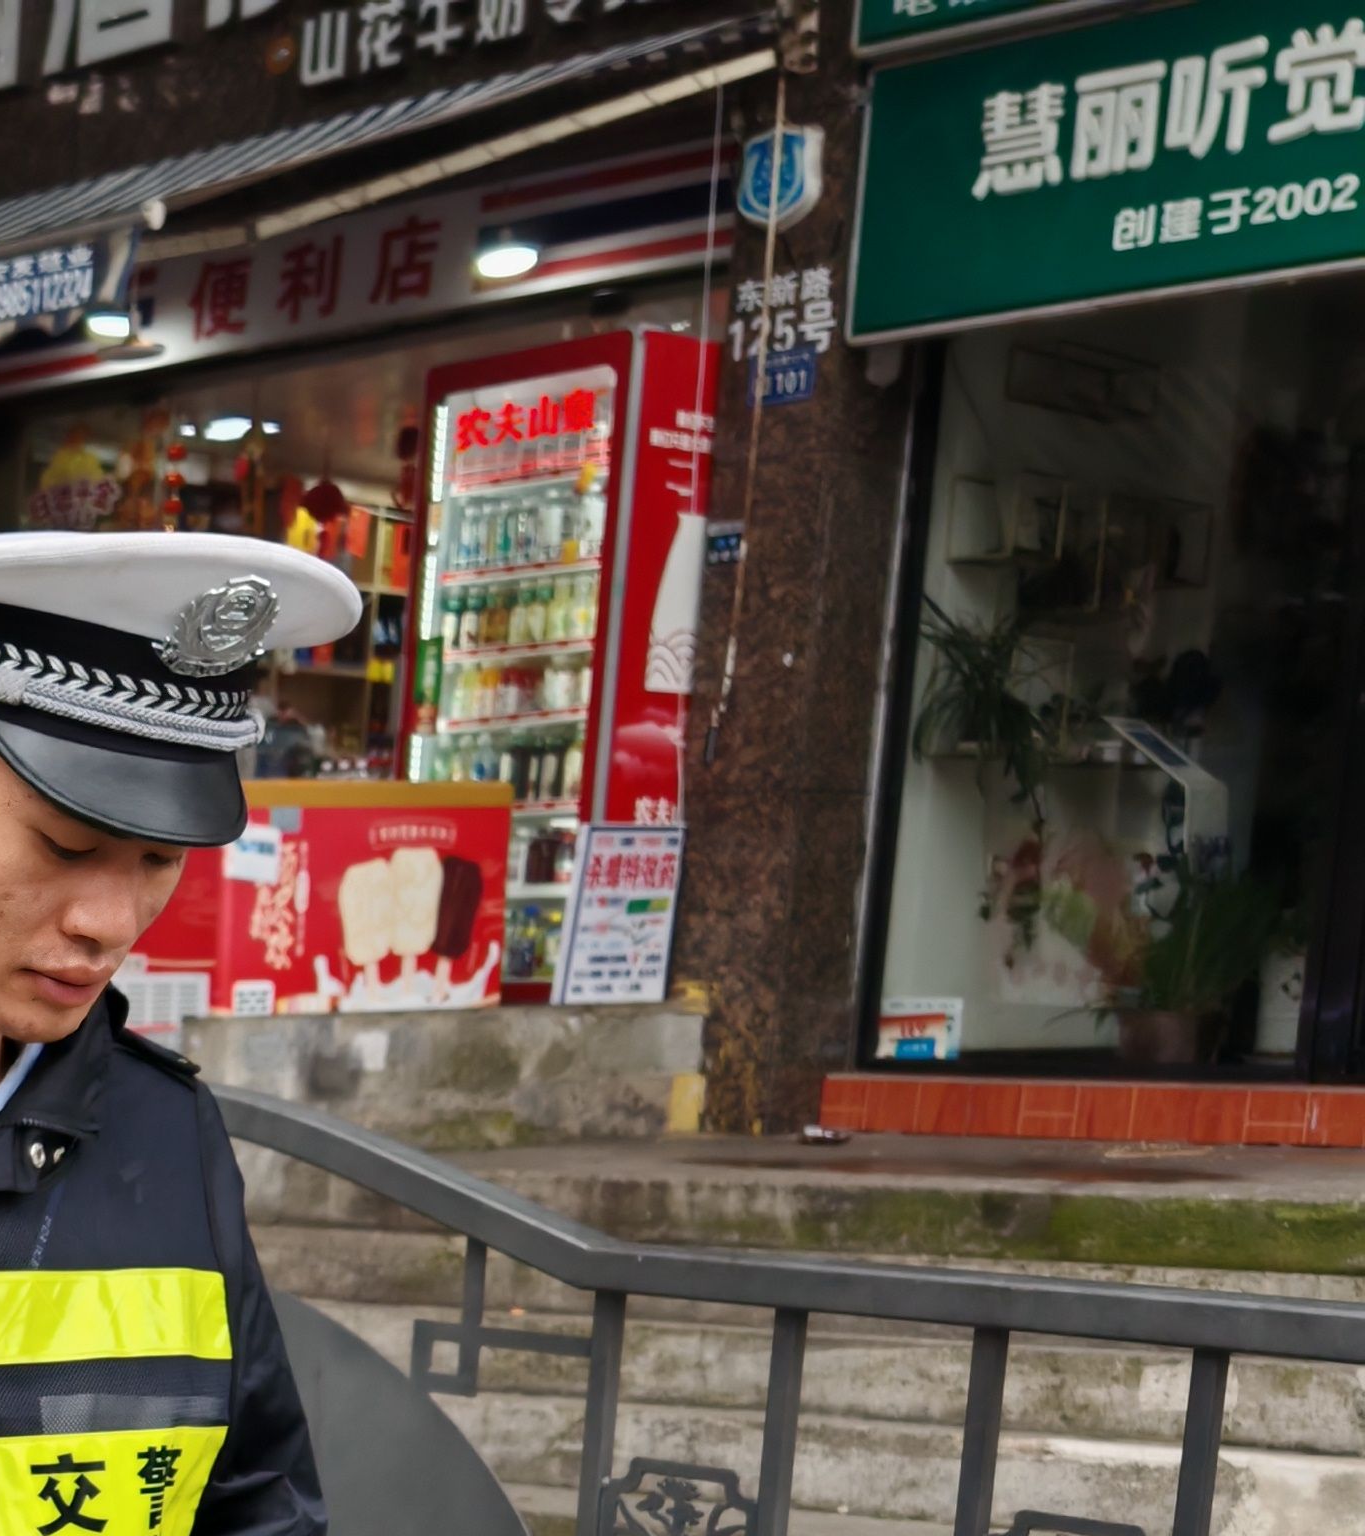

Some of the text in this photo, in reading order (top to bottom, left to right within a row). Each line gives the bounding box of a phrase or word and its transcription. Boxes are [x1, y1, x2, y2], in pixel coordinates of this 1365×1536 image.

[971, 17, 1365, 201] 慧丽听觉
[1112, 173, 1361, 252] 创建于2002
[189, 216, 442, 342] 便利店
